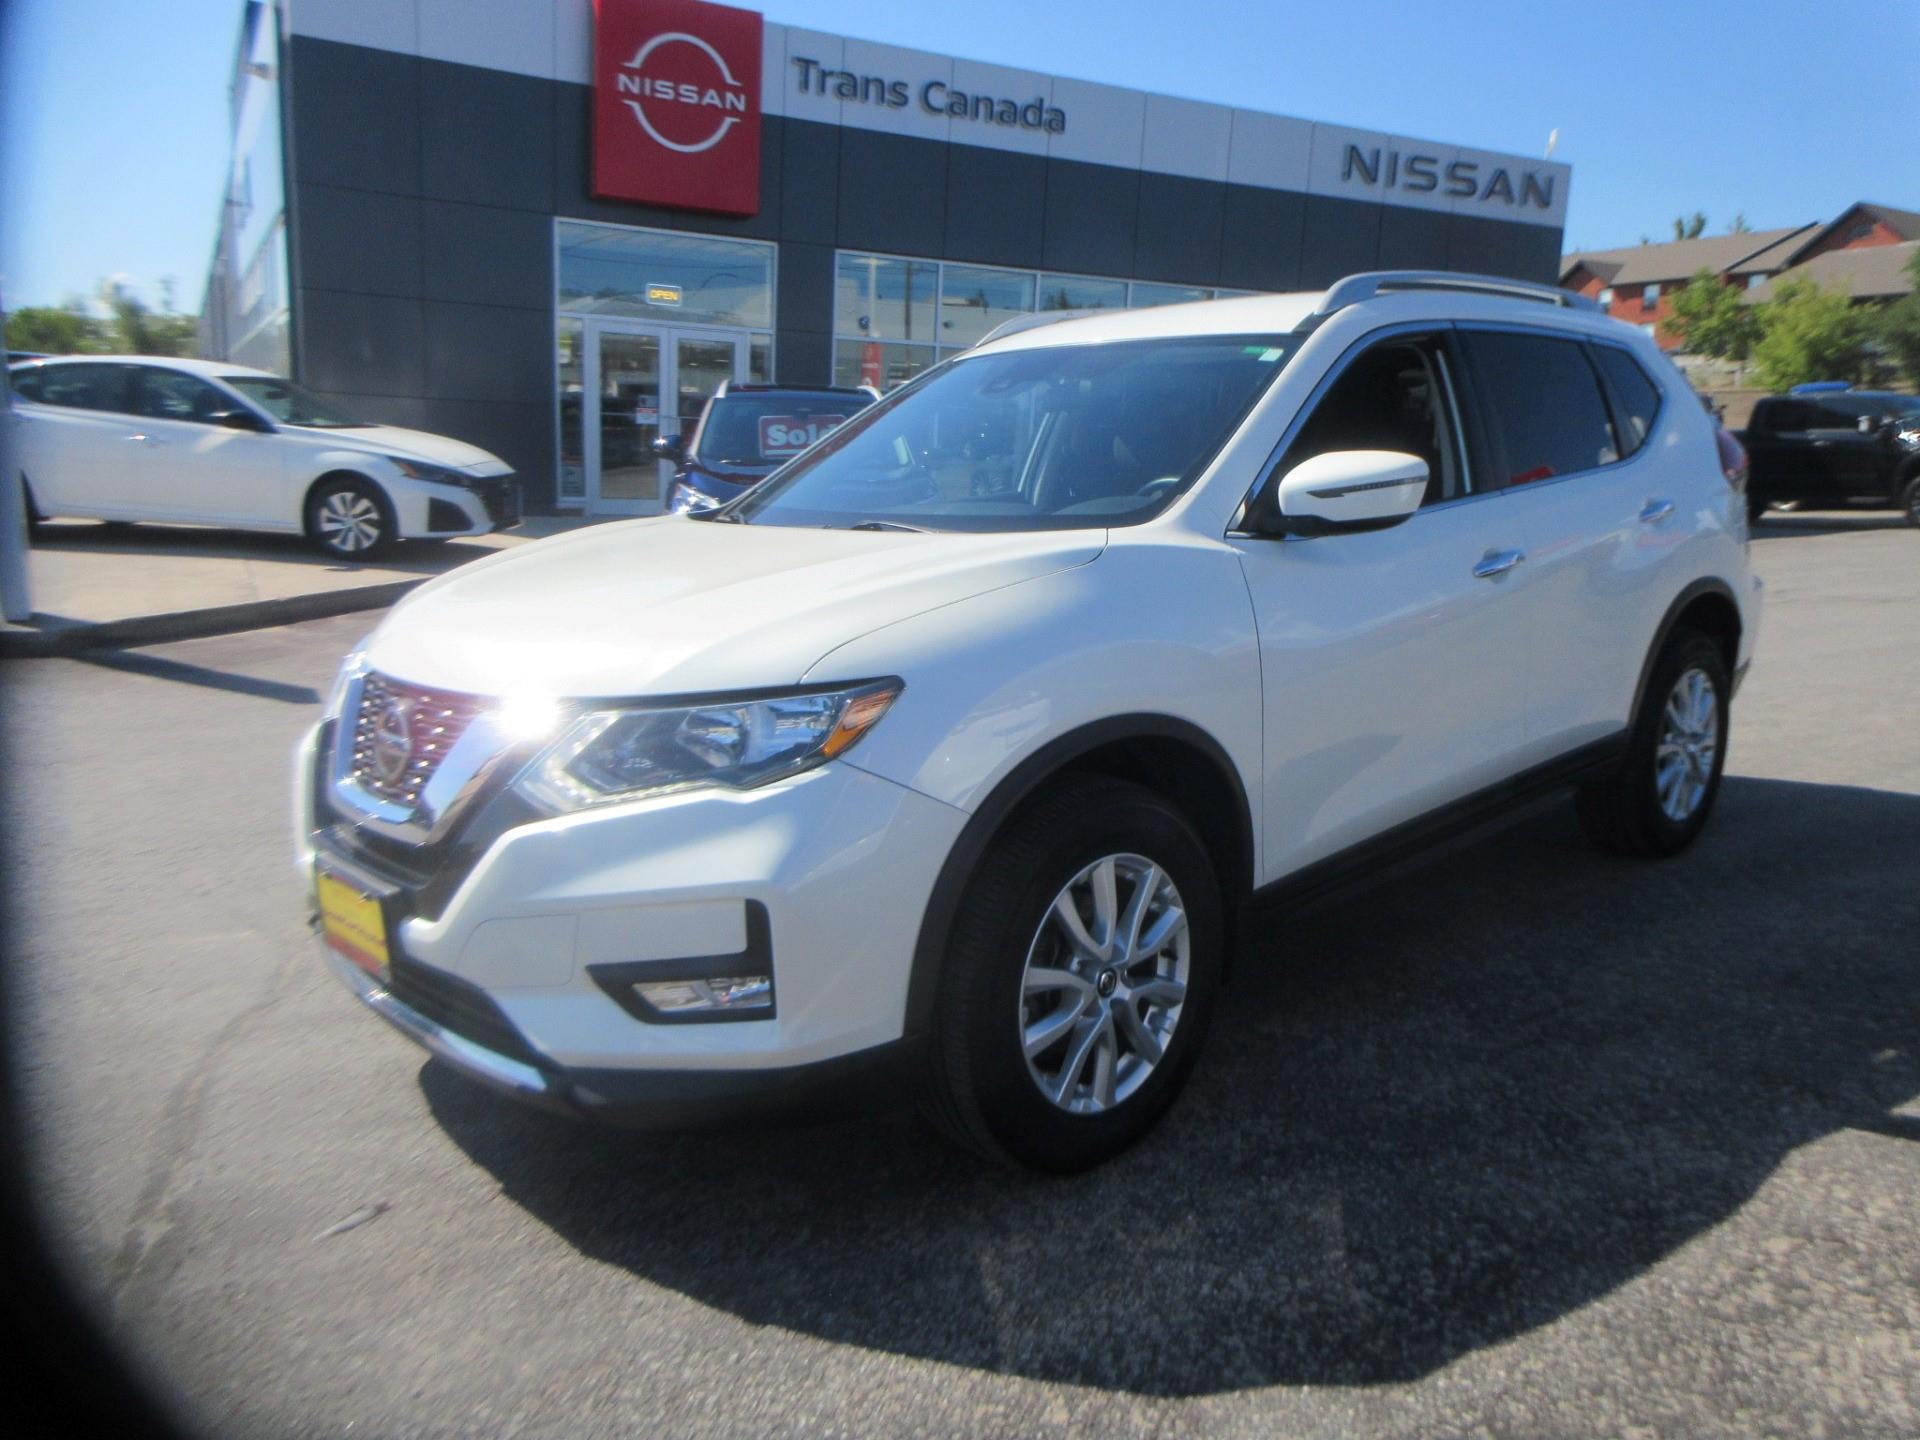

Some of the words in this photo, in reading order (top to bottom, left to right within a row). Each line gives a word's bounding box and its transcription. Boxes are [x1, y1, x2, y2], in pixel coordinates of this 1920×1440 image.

[616, 73, 746, 112] NISSAN
[792, 57, 909, 108] Trans
[919, 80, 1066, 134] Canada
[1341, 144, 1554, 209] NISSAN
[650, 289, 679, 301] OPEN
